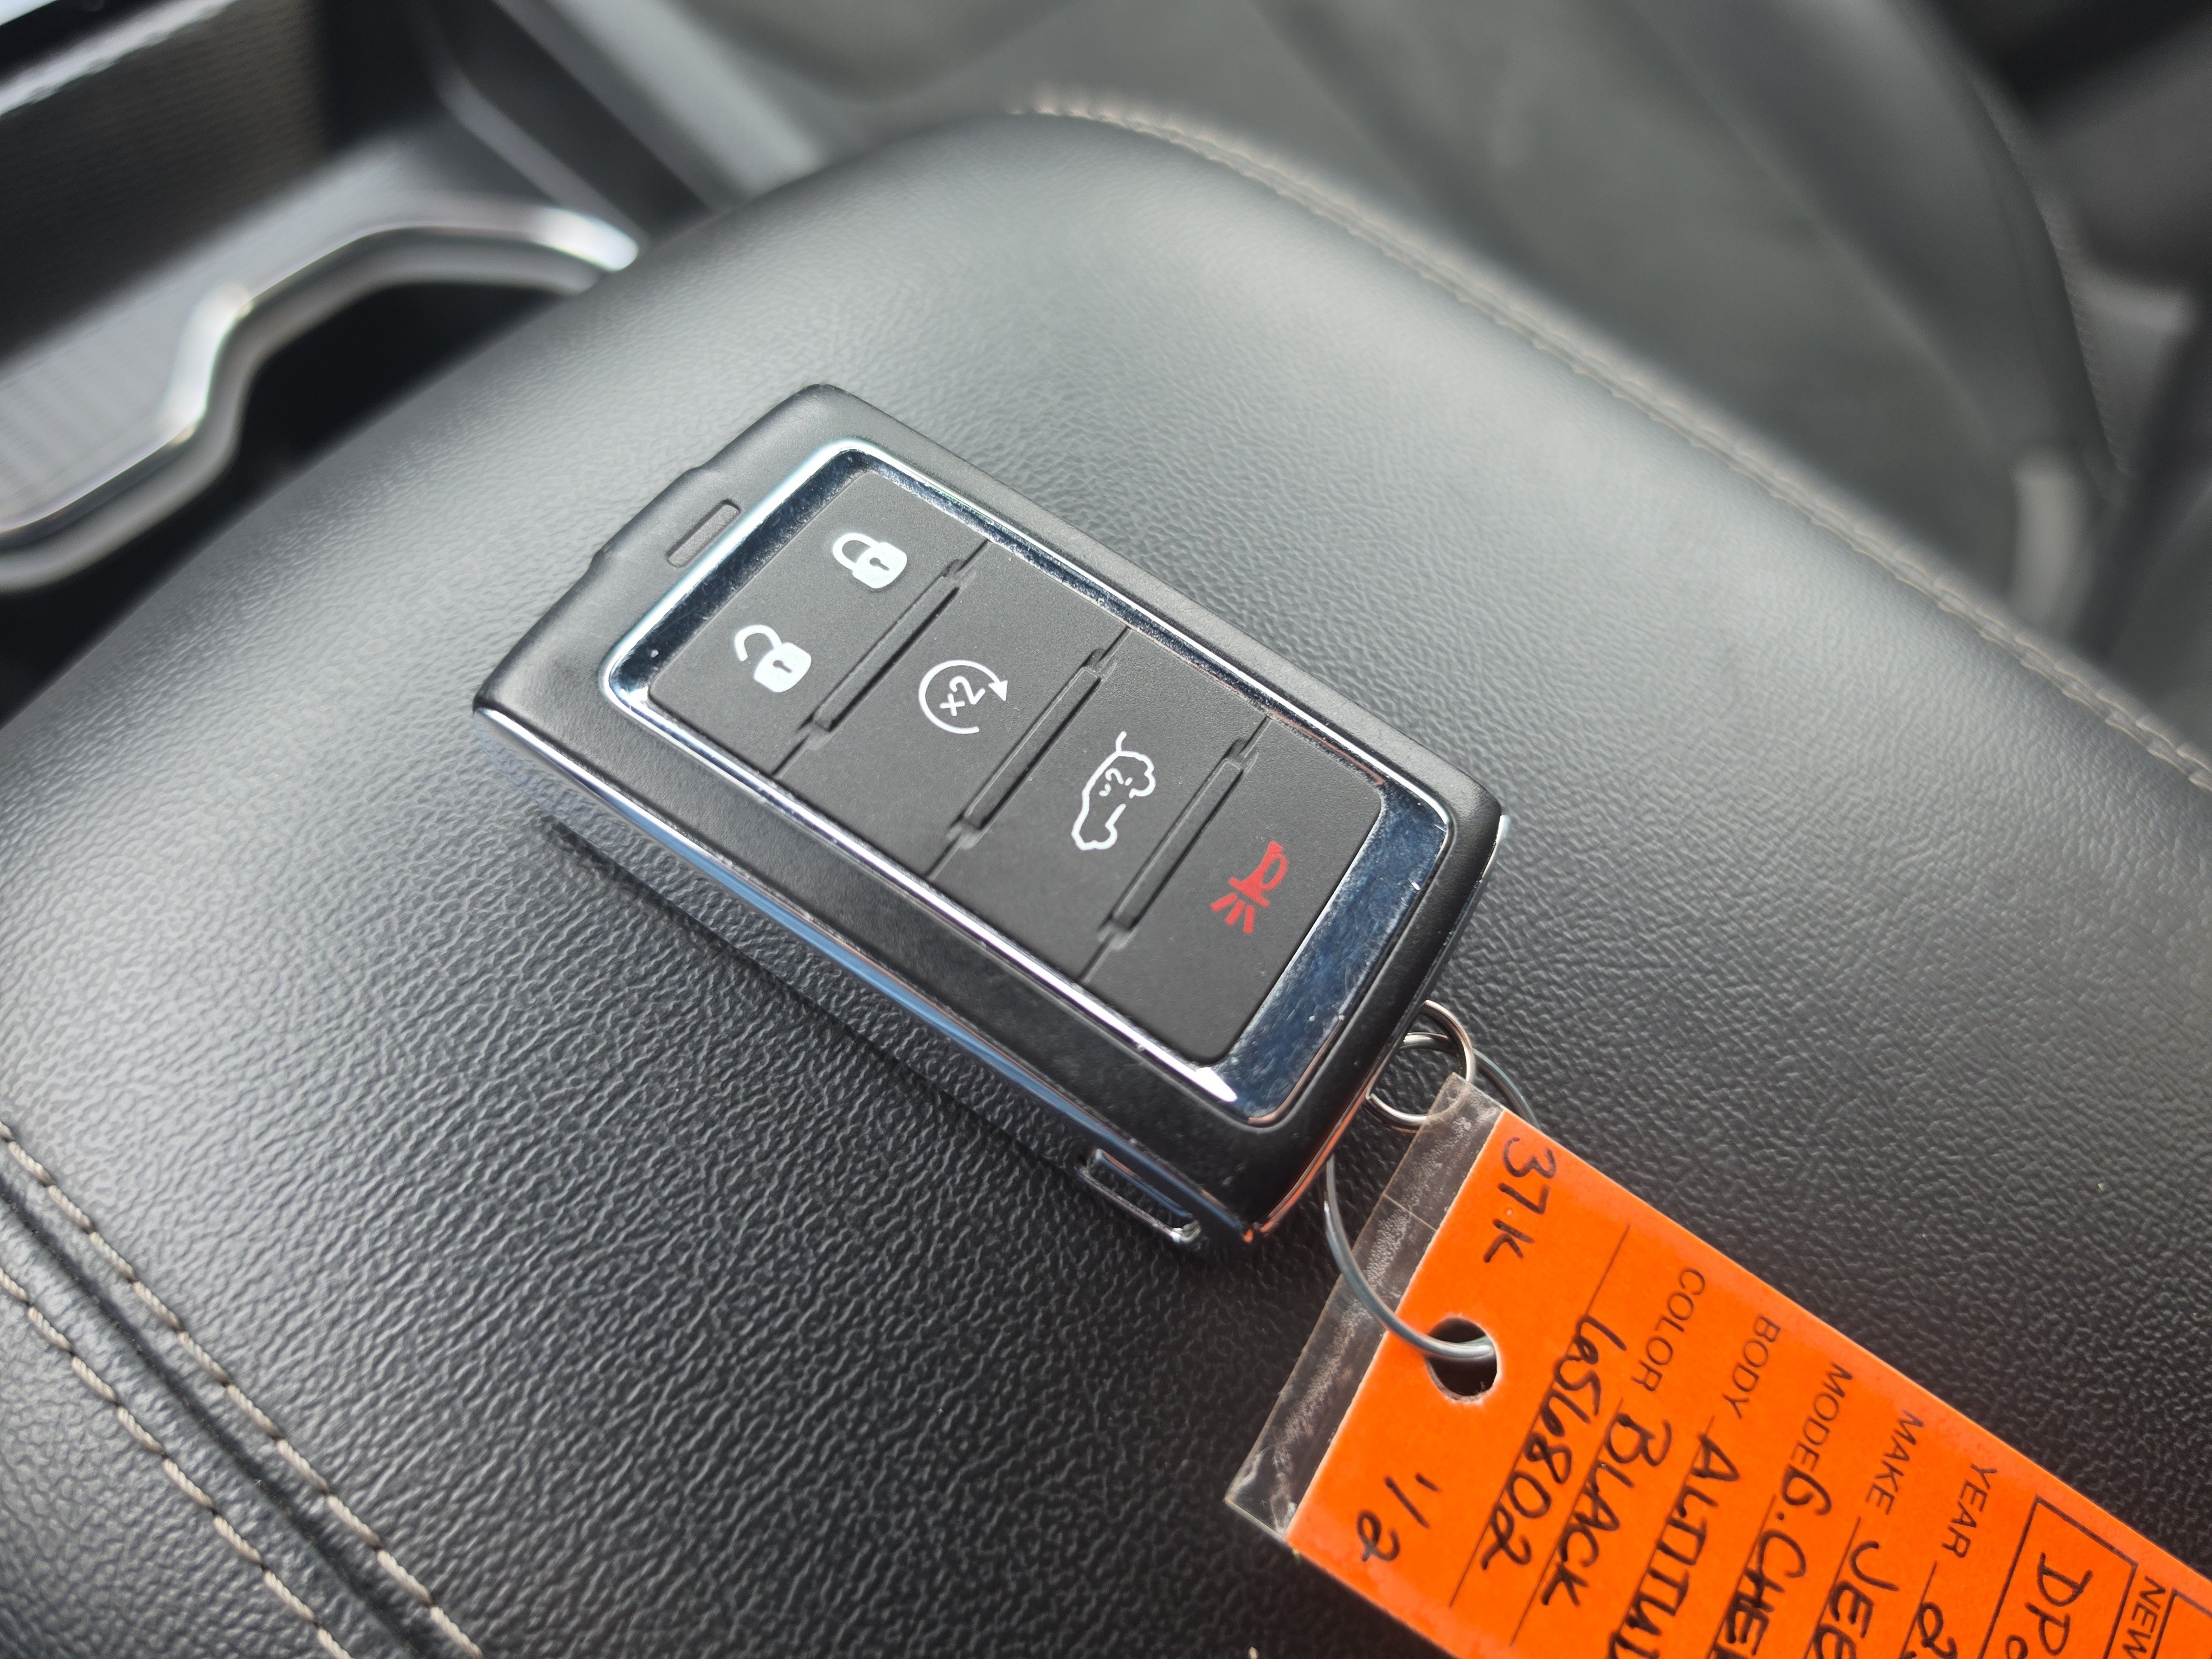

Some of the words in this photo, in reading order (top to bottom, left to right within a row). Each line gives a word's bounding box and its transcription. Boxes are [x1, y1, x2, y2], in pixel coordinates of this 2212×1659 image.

[1631, 1267, 1705, 1391] COLOR
[1722, 1314, 1781, 1419] BODY
[1482, 1314, 1626, 1571] 656802
[1790, 1362, 1853, 1472] MODE
[1866, 1410, 1924, 1515] MAKE
[1541, 1413, 1671, 1606] BLACK
[1941, 1463, 1997, 1558] YEAR
[2122, 1576, 2166, 1659] NEW
